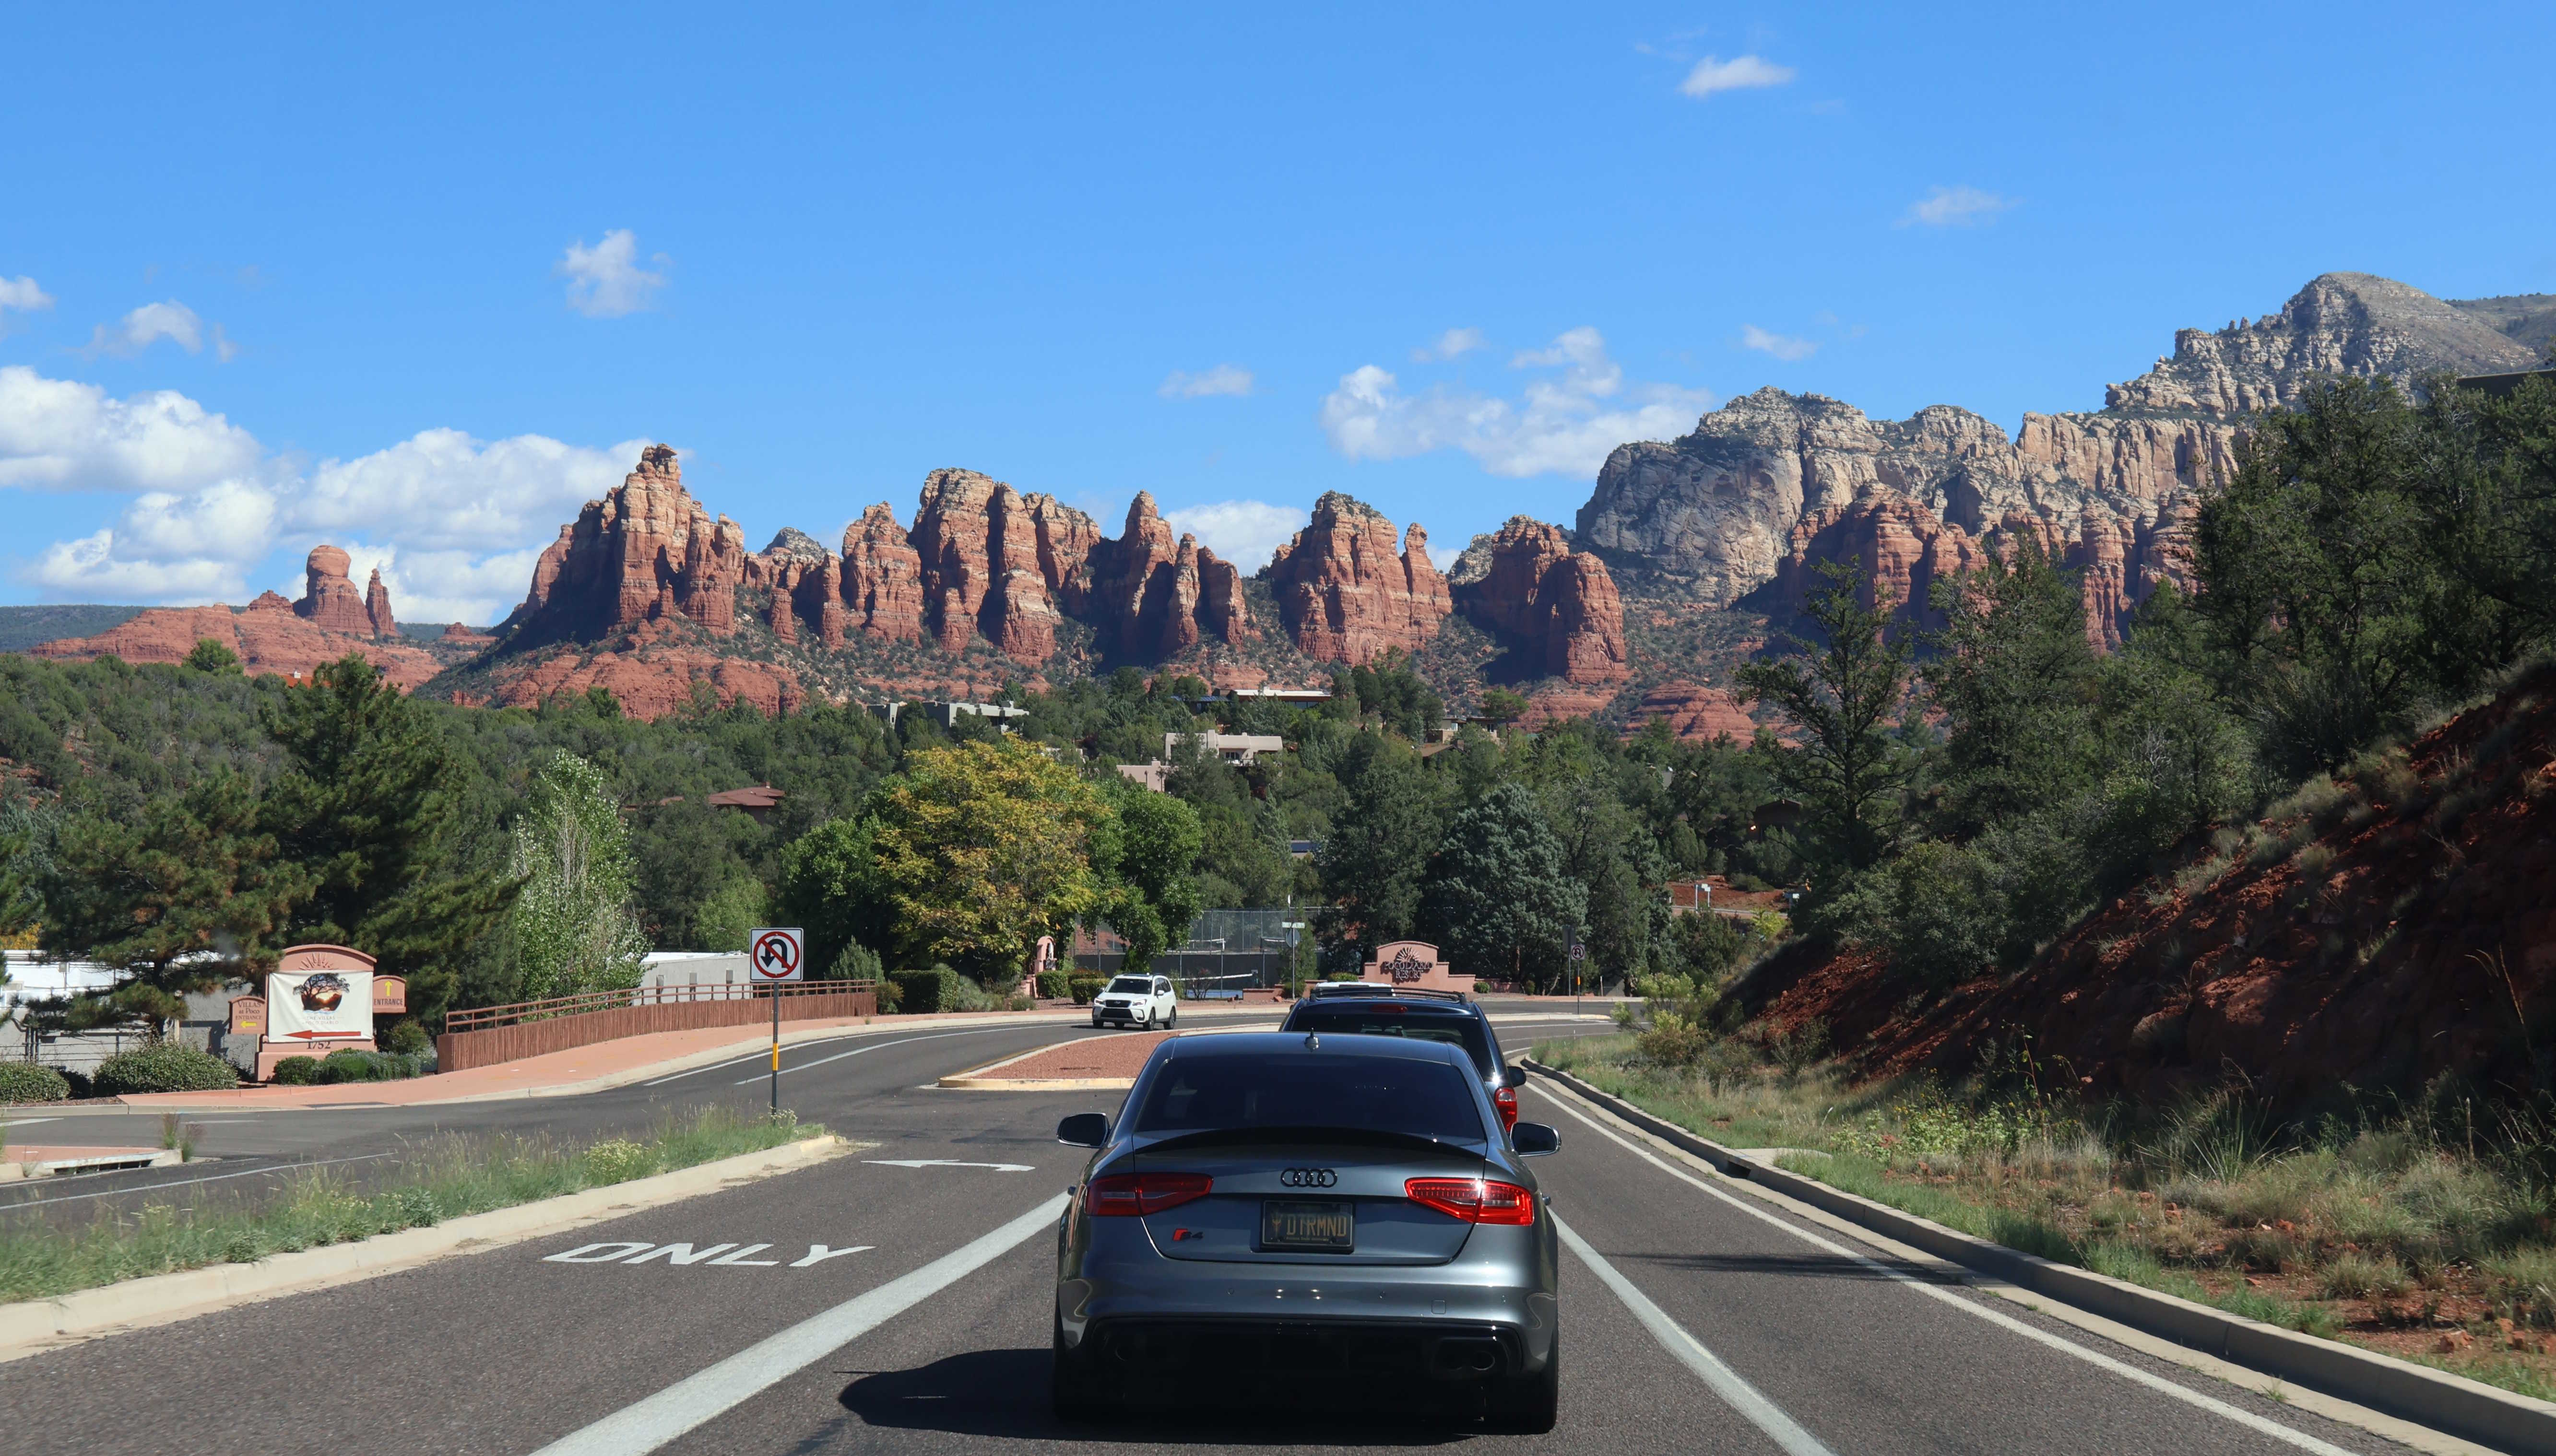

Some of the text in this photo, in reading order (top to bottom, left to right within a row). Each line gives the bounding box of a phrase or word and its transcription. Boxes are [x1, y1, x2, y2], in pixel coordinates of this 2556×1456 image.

[1396, 970, 1423, 981] RESORT
[307, 1041, 331, 1049] 1752
[1286, 1213, 1347, 1237] DTRMND
[542, 1243, 877, 1267] ONLY
